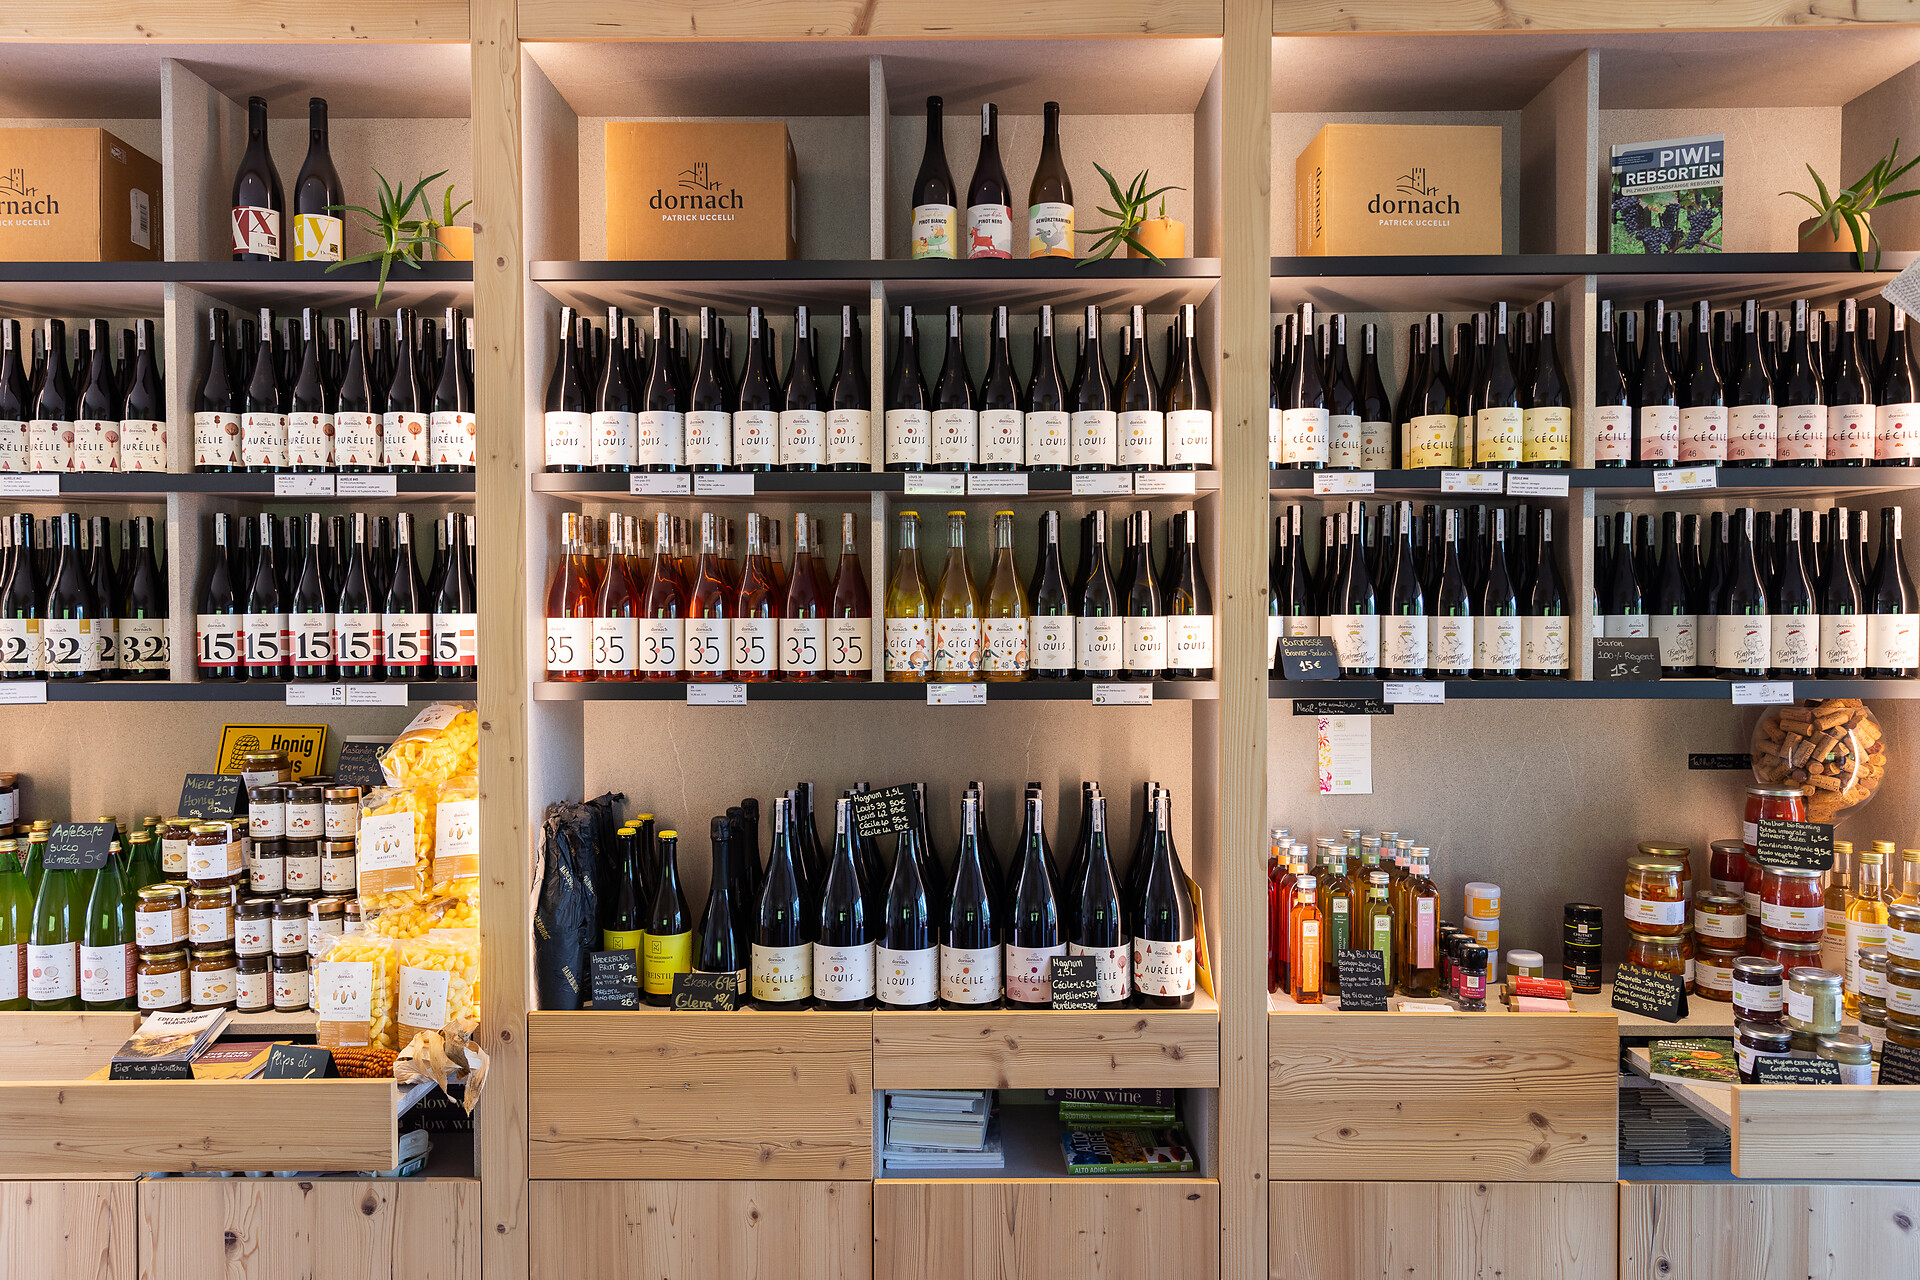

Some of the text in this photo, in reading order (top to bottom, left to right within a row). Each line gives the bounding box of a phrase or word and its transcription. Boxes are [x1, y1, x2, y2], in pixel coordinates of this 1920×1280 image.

[1660, 146, 1720, 167] PIWI-
[1626, 164, 1720, 186] REBSORTEN
[1626, 180, 1720, 194] PILZWIDERSTANDSFÄHIGE REBSORTEN
[649, 189, 744, 210] dornach
[1368, 194, 1460, 214] dornach
[337, 434, 374, 445] AURÉLIE
[1294, 430, 1325, 444] CÉCILE
[1493, 430, 1523, 444] CÉCILE
[1534, 430, 1568, 444] CÉCILE
[1694, 430, 1726, 442] CÉCILE
[1742, 429, 1776, 440] CÉCILE
[1787, 429, 1823, 440] CÉCILE
[1832, 429, 1868, 440] CÉCILE
[1878, 428, 1918, 440] CÉCILE
[248, 435, 287, 446] AURÉLIE
[550, 437, 578, 447] LOUIS
[598, 437, 626, 447] LOUIS
[742, 437, 769, 447] LOUIS
[788, 436, 816, 446] LOUIS
[830, 436, 856, 446] LOUIS
[898, 436, 925, 446] LOUIS
[940, 436, 968, 446] LOUIS
[993, 436, 1020, 446] LOUIS
[1040, 436, 1067, 447] LOUIS
[1079, 436, 1106, 447] LOUIS
[1126, 436, 1153, 447] LOUIS
[1182, 436, 1209, 446] LOUIS
[1329, 436, 1359, 450] CÉCILE
[1421, 436, 1453, 450] CÉCILE
[892, 452, 899, 461] 38
[1736, 449, 1746, 457] 46
[203, 632, 235, 660] 15
[247, 632, 278, 659] 15
[298, 631, 331, 658] 15
[340, 632, 370, 659] 15
[387, 632, 418, 659] 15
[434, 632, 457, 659] 15
[1038, 641, 1066, 651] LOUIS
[1088, 642, 1116, 652] LOUIS
[1133, 641, 1161, 652] LOUIS
[1178, 641, 1204, 651] LOUIS
[1282, 638, 1324, 647] Baronesse
[1596, 639, 1624, 647] Baron
[45, 637, 82, 664] 32
[124, 636, 164, 662] 32
[548, 636, 573, 664] 35
[596, 636, 625, 665] 35
[644, 637, 675, 665] 35
[690, 637, 720, 665] 35
[736, 637, 766, 665] 35
[787, 637, 817, 665] 35
[832, 636, 863, 664] 35
[1624, 652, 1655, 663] Regent
[896, 661, 903, 670] 48
[1299, 660, 1322, 672] 15€
[332, 687, 342, 696] 15
[271, 734, 314, 758] Honig
[185, 778, 215, 789] Miele
[184, 795, 214, 810] Honig
[856, 802, 875, 813] Louis
[889, 798, 906, 807] 50€
[857, 811, 875, 822] Louis
[859, 820, 881, 830] Cécile
[52, 824, 104, 843] Apfelsaft
[50, 844, 78, 852] succo
[44, 854, 80, 864] di mela
[646, 971, 673, 980] FREISTIL
[1145, 965, 1183, 975] AURÉLIE
[1642, 968, 1652, 976] Bio
[715, 976, 736, 991] 69€
[761, 973, 794, 984] CÉCILE
[825, 974, 853, 982] LOUIS
[886, 977, 915, 986] LOUIS
[950, 973, 984, 984] CÉCILE
[1018, 974, 1051, 984] CÉCILE
[298, 1053, 312, 1068] di
[114, 1063, 131, 1073] Eier
[1065, 1088, 1141, 1103] slow wine
[416, 1096, 448, 1109] slow
[415, 1115, 448, 1129] slow
